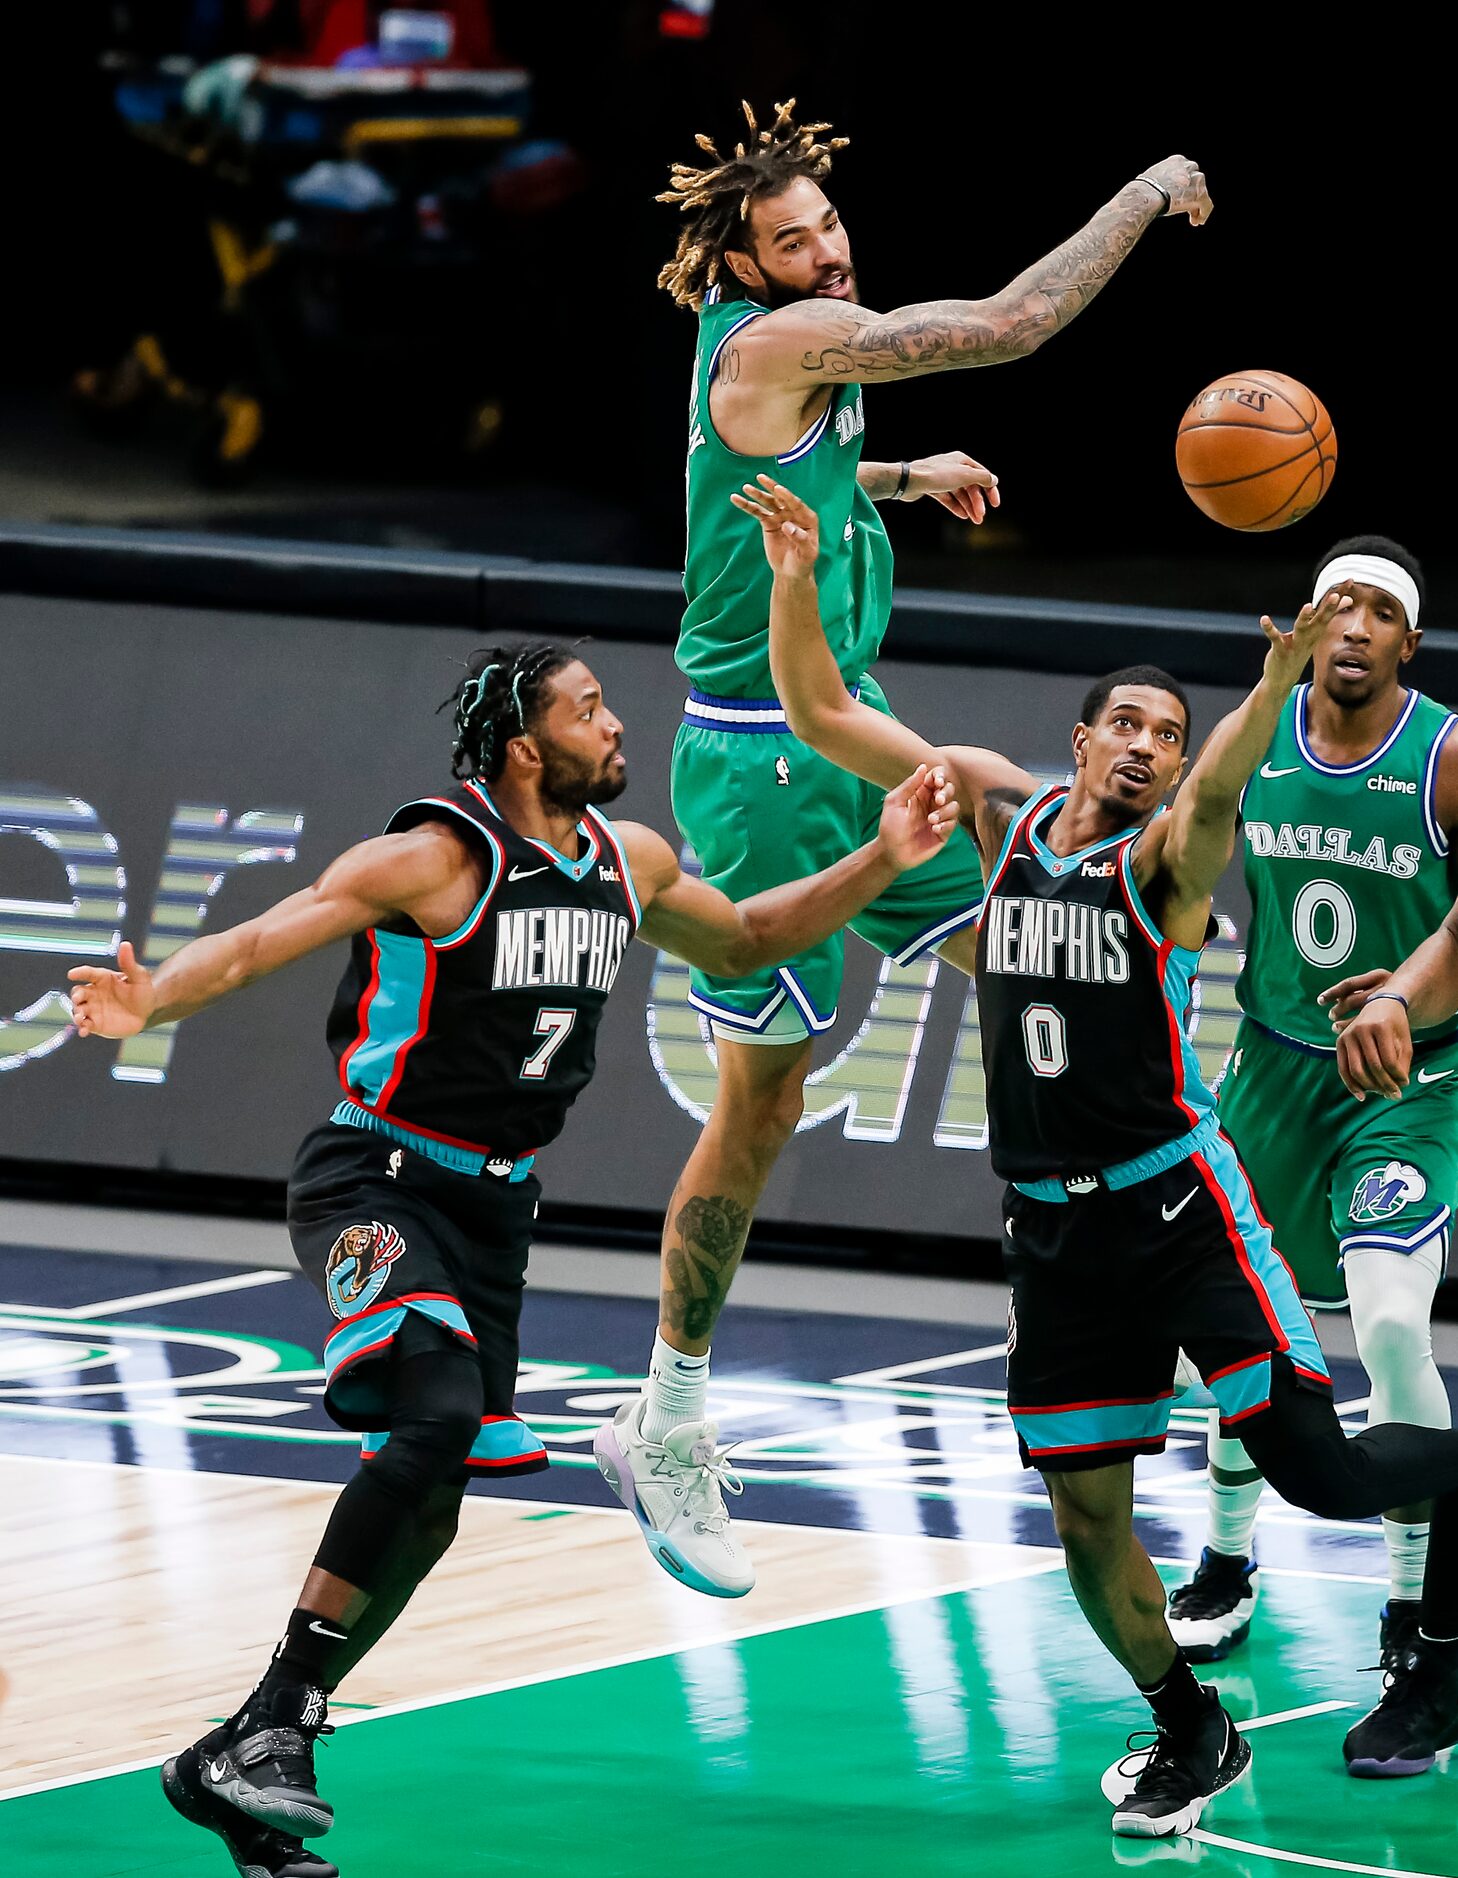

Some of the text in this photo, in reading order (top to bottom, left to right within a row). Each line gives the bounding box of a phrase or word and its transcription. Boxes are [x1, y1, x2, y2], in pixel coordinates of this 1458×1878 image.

[1367, 774, 1417, 795] chime
[1244, 822, 1422, 879] DALLAS
[491, 907, 630, 994] MEMPHIS
[986, 895, 1130, 984] MEMPHIS
[1292, 878, 1357, 969] 0
[519, 1007, 577, 1080] 7
[1021, 1003, 1069, 1078] 0
